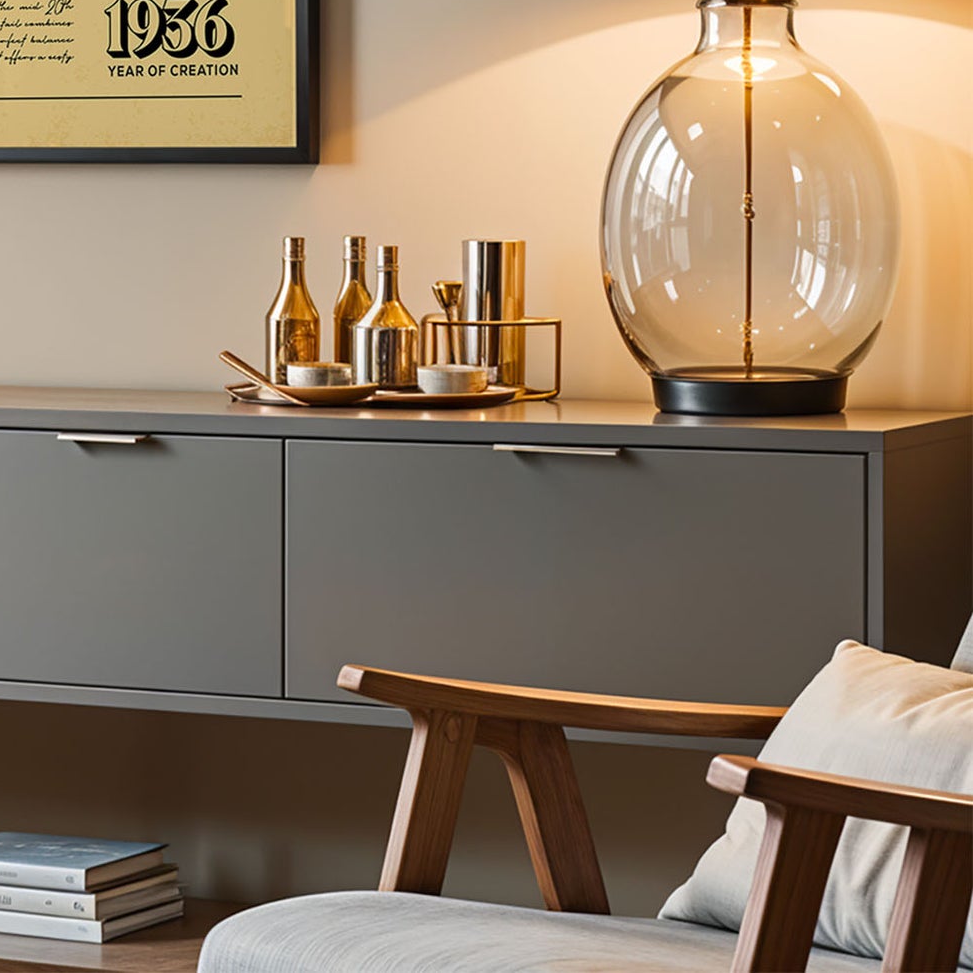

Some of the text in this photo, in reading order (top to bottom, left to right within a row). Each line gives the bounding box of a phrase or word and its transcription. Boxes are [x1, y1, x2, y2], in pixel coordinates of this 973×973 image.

[24, 18, 74, 27] combines
[30, 35, 74, 44] balance
[4, 49, 35, 65] offers
[107, 64, 239, 77] YEAR OF CREATION
